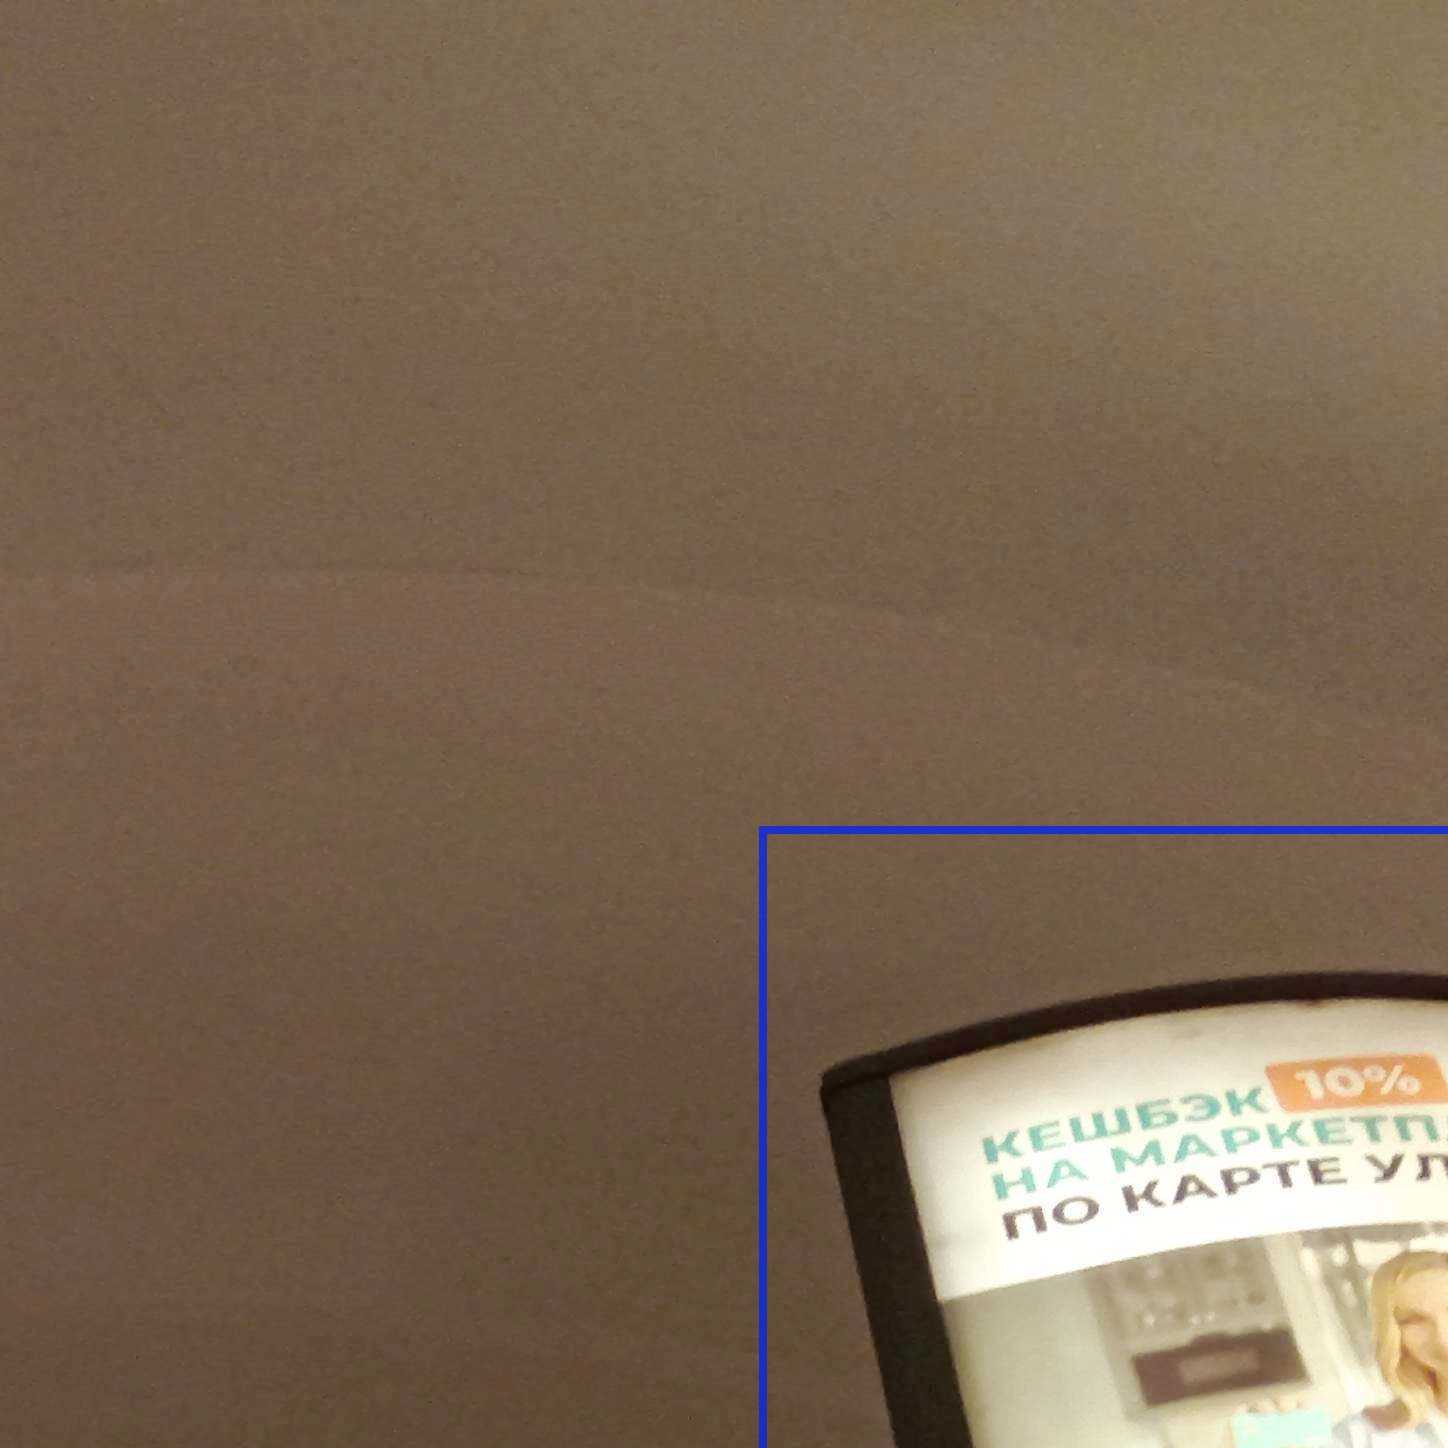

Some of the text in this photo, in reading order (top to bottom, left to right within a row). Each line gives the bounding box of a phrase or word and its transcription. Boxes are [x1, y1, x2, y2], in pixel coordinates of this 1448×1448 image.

[982, 1063, 1422, 1164] КЕШБЭК 10%
[992, 1159, 1088, 1201] НА
[1002, 1196, 1100, 1240] ПО
[1122, 1157, 1347, 1213] КАРТЕ
